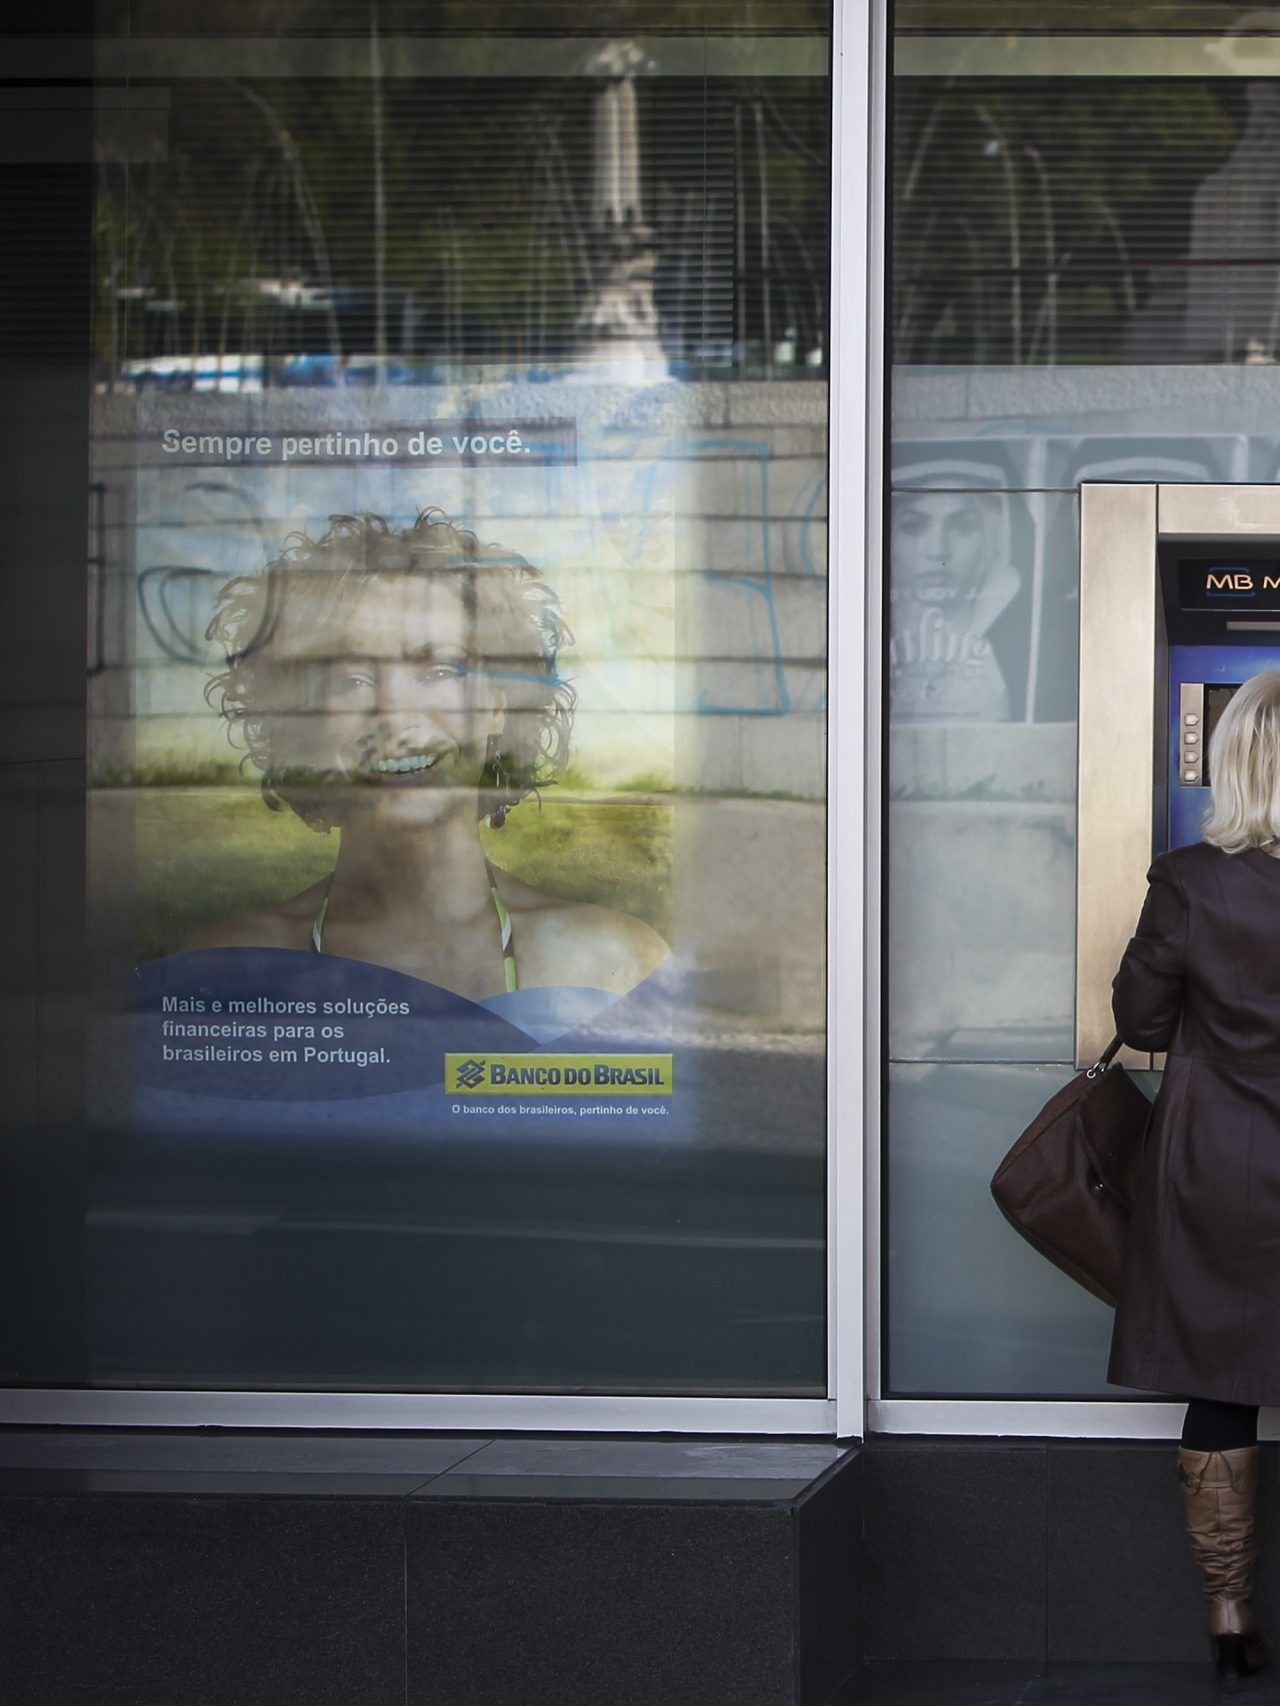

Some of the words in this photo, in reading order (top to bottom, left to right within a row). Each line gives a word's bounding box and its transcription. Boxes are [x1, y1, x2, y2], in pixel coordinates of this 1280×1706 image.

[162, 429, 272, 460] Sempre
[282, 432, 399, 461] pertinho
[408, 431, 443, 456] de
[452, 430, 531, 455] você.
[1206, 574, 1254, 590] MB
[162, 996, 206, 1013] Mais
[211, 1001, 222, 1013] e
[228, 997, 317, 1014] melhores
[322, 998, 410, 1018] soluções
[162, 1020, 267, 1038] financeiras
[273, 1024, 315, 1041] para
[321, 1025, 344, 1038] os
[162, 1045, 263, 1062] brasileiros
[269, 1049, 297, 1062] em
[304, 1047, 391, 1067] Portugal.
[490, 1063, 561, 1086] BANCO
[564, 1067, 592, 1086] DO
[594, 1064, 664, 1086] BRASIL
[452, 1105, 461, 1114] O
[463, 1104, 495, 1114] banco
[497, 1104, 517, 1114] dos
[519, 1104, 577, 1116] brasileiros,
[579, 1105, 623, 1117] pertinho
[625, 1105, 638, 1115] de
[641, 1105, 669, 1115] você.
